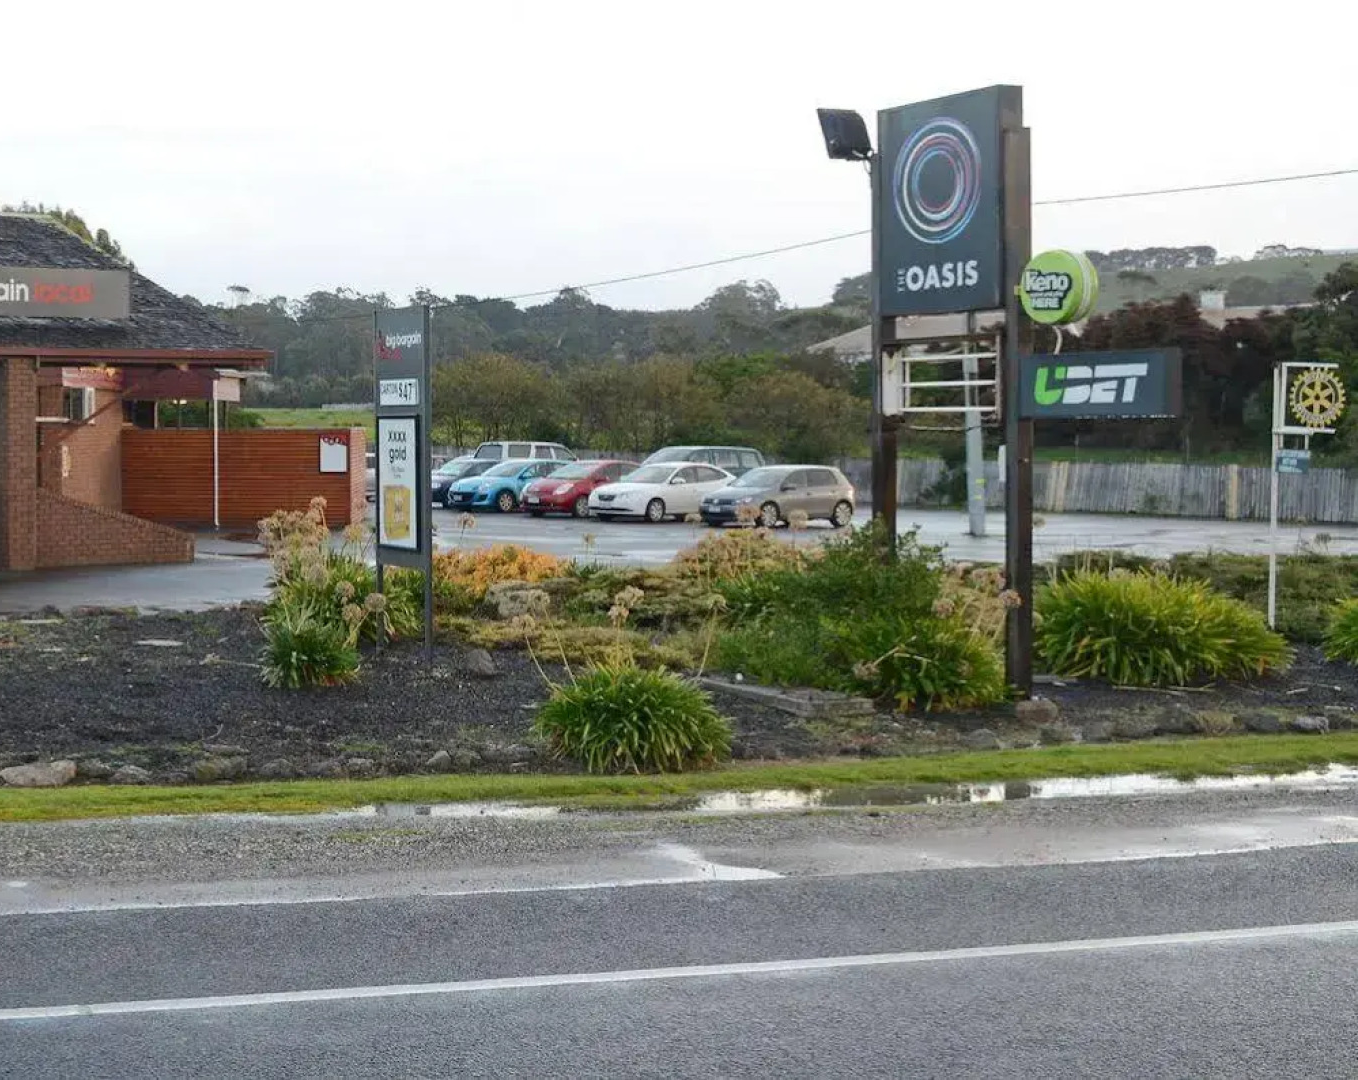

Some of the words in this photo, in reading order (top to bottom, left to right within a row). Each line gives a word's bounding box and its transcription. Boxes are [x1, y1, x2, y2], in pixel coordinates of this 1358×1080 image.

[905, 260, 979, 291] OASIS
[1034, 362, 1149, 406] UBET
[389, 445, 407, 464] gold
